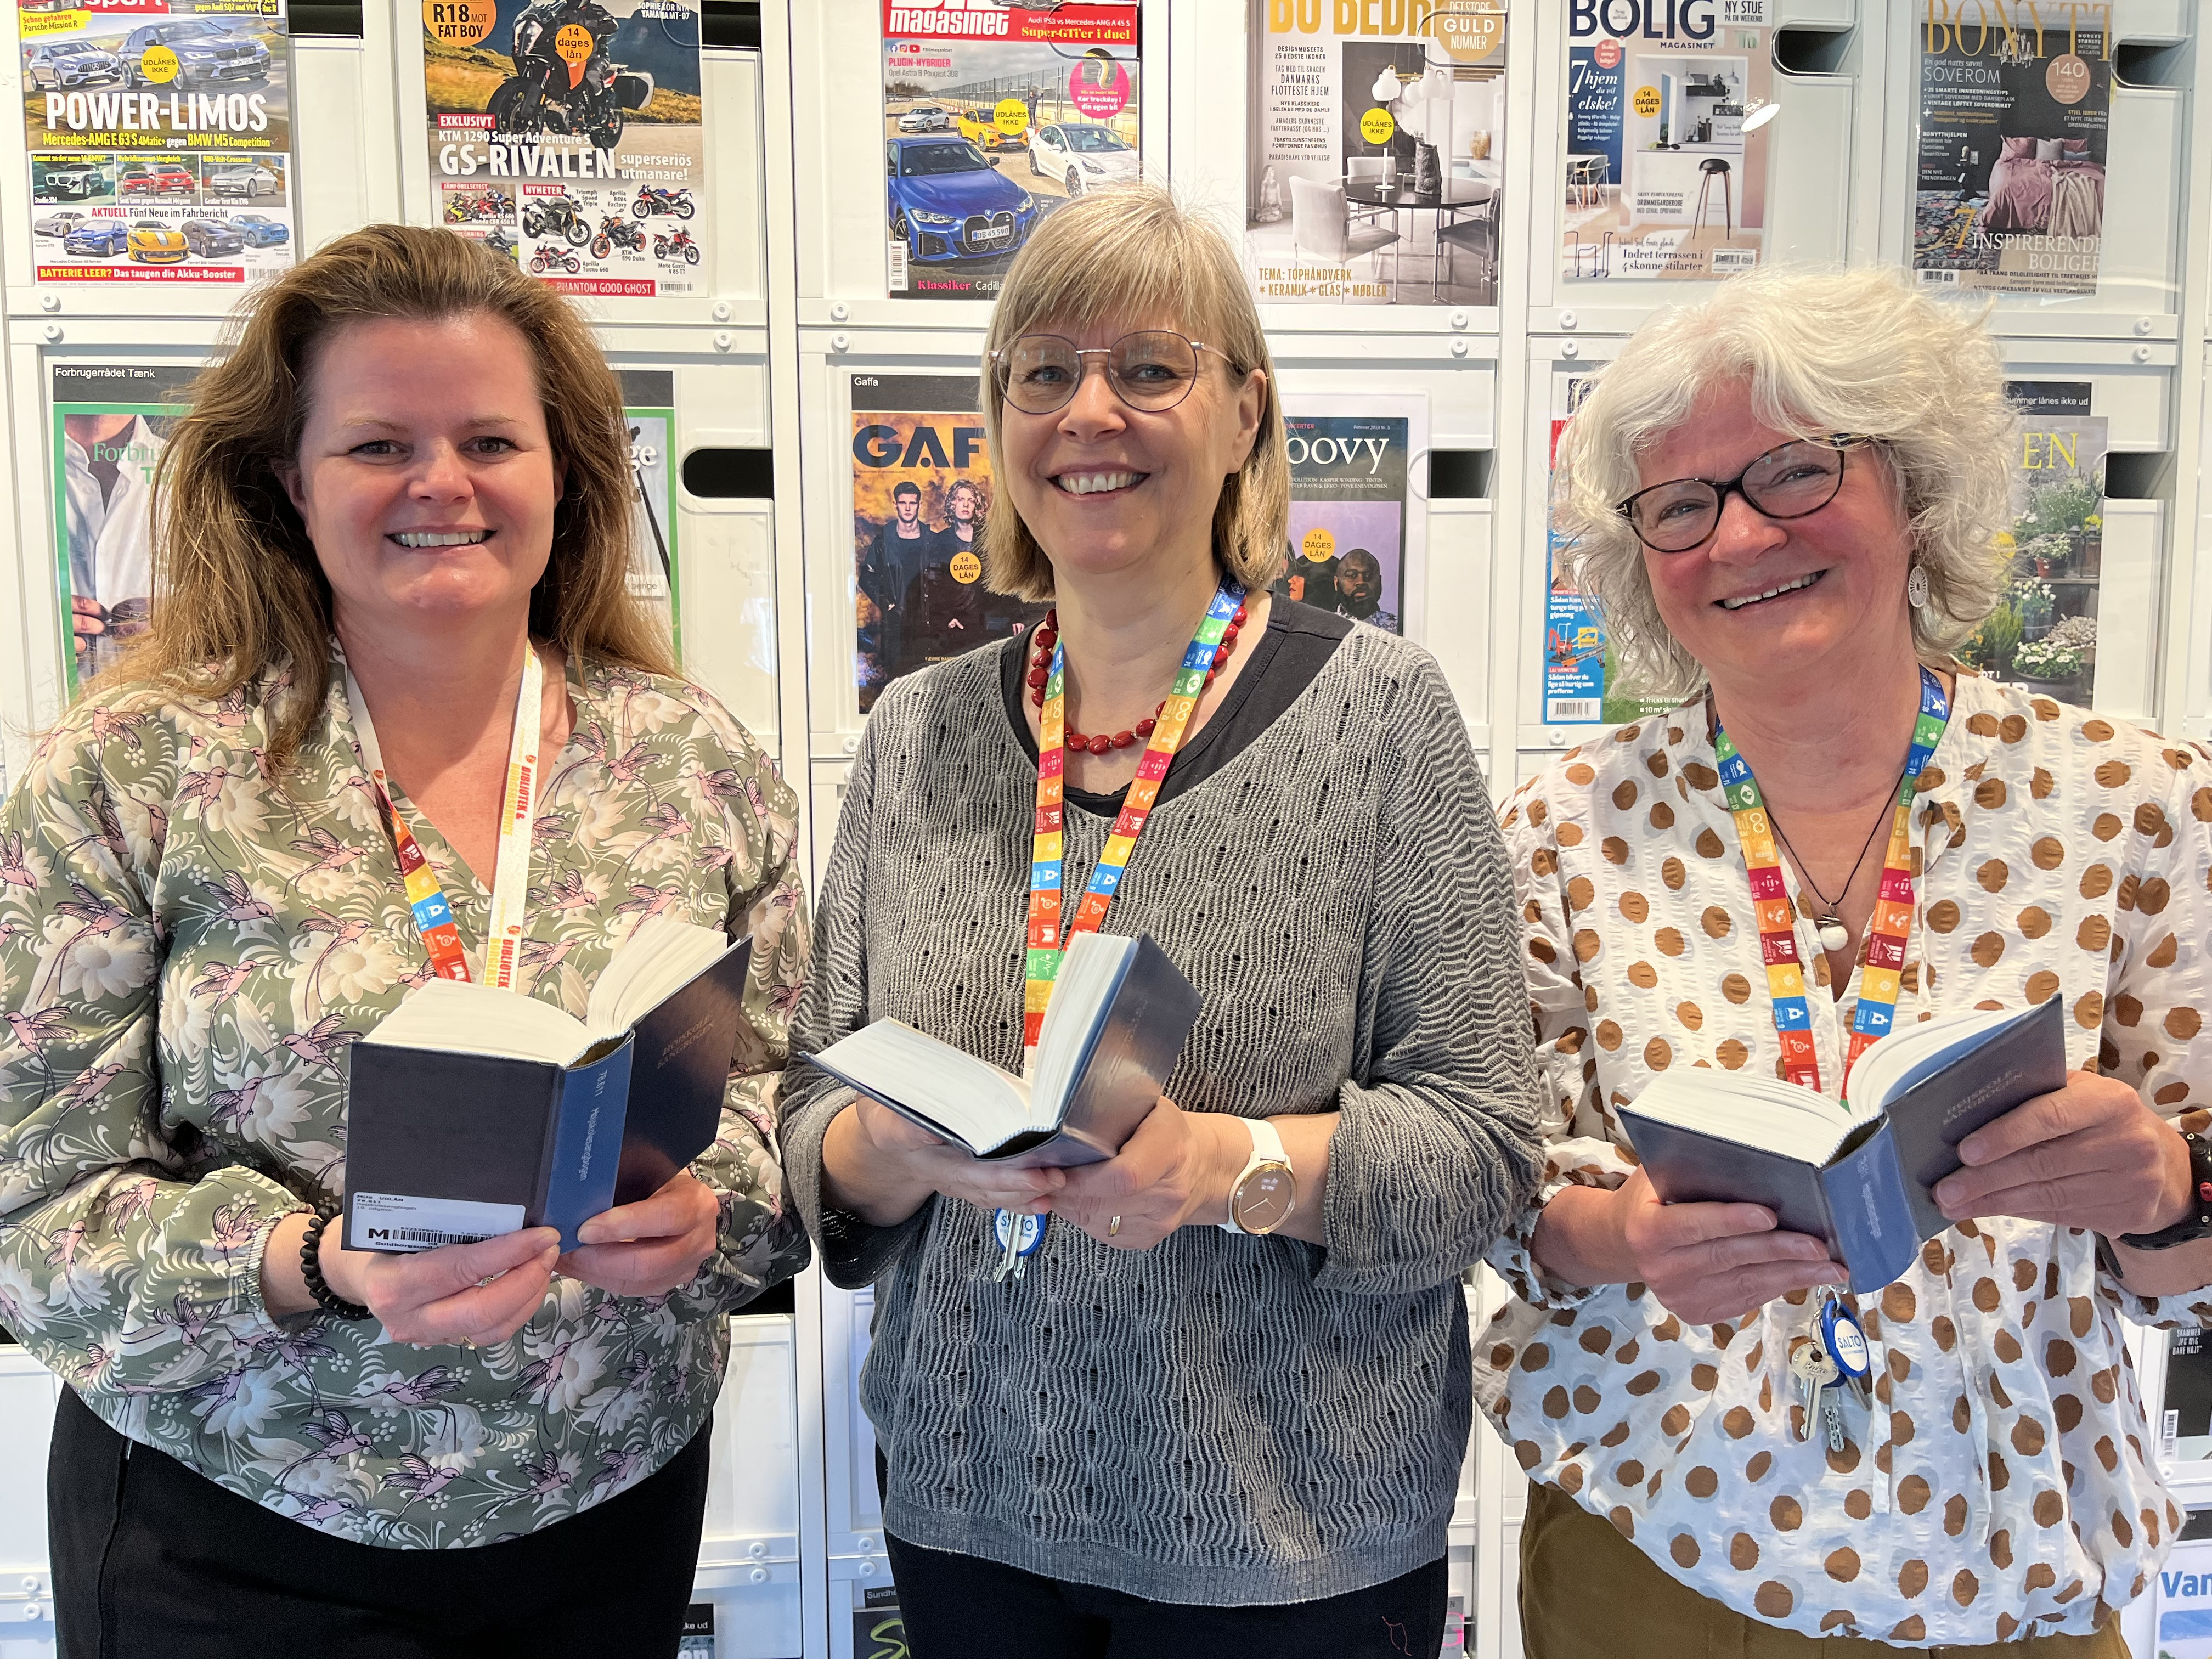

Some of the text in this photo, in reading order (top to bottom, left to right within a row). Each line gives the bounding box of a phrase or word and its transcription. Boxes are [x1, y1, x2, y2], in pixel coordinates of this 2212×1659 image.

[433, 4, 487, 22] R18 MOT
[1725, 1, 1763, 14] NY STUE
[43, 14, 72, 22] gefahren
[889, 9, 1009, 35] magasinet
[1570, 0, 1715, 40] BOLIG
[25, 23, 48, 31] Porsche
[438, 25, 483, 37] FAT BOY
[1443, 18, 1494, 33] GULD
[1922, 0, 2112, 61] BONYTT
[568, 28, 579, 36] 14
[1097, 29, 1101, 38] i
[1104, 29, 1130, 40] duel
[558, 38, 589, 48] dages
[1451, 36, 1487, 49] NUMMER
[566, 49, 582, 58] lån
[889, 58, 951, 67] PLUGIN-HYBRIDER
[1934, 59, 1946, 67] god
[1924, 67, 2000, 83] SOVEROM
[2052, 62, 2085, 78] 140
[1281, 74, 1320, 84] DANMARKS
[1571, 60, 1618, 94] 7 hjem
[1272, 86, 1329, 96] FLOTTESTE HJEM
[1578, 96, 1617, 110] elske!
[1641, 105, 1654, 113] LÅN
[46, 92, 268, 132] POWER-LIMOS
[441, 116, 492, 127] EXKLUSIVT
[43, 132, 270, 148] Mercedes-AMG E 63 S 4Matic+ gegen BMW M5 Competition
[439, 130, 591, 145] KTM 1290 Super Adventure S
[439, 144, 616, 179] GS-RIVALEN
[621, 153, 692, 167] superseriös
[621, 169, 687, 180] utmanare!
[526, 185, 562, 195] NYHETER
[92, 208, 228, 218] AKTUELL Fünf Neue im Fahrbericht
[1955, 208, 1976, 249] 7
[1623, 249, 1697, 259] Indret terrassen
[40, 269, 83, 278] BATTERIE
[85, 269, 112, 278] LEER?
[114, 269, 130, 278] Das
[131, 270, 160, 279] taugen
[177, 269, 236, 279] Akku-Booster
[1259, 268, 1352, 281] TEMA: TOPHÅNDVÆRK
[557, 282, 597, 292] PHANTOM
[600, 283, 622, 294] GOOD
[625, 284, 651, 294] GHOST
[918, 280, 971, 290] Klassiker
[1269, 284, 1387, 297] KERAMIK GLAS MØBLER
[55, 367, 155, 379] Forbrugerrådet Tænk
[854, 377, 878, 386] Gaffa
[2038, 396, 2089, 406] lånes ikke ud
[1310, 549, 1325, 557] LÅN
[517, 766, 531, 812] BIBLIOTEK
[502, 762, 521, 836] BORGERSERVICE
[498, 939, 514, 988] BIBLIOTEK
[368, 1228, 389, 1240] M
[1838, 1335, 1861, 1348] SALTO
